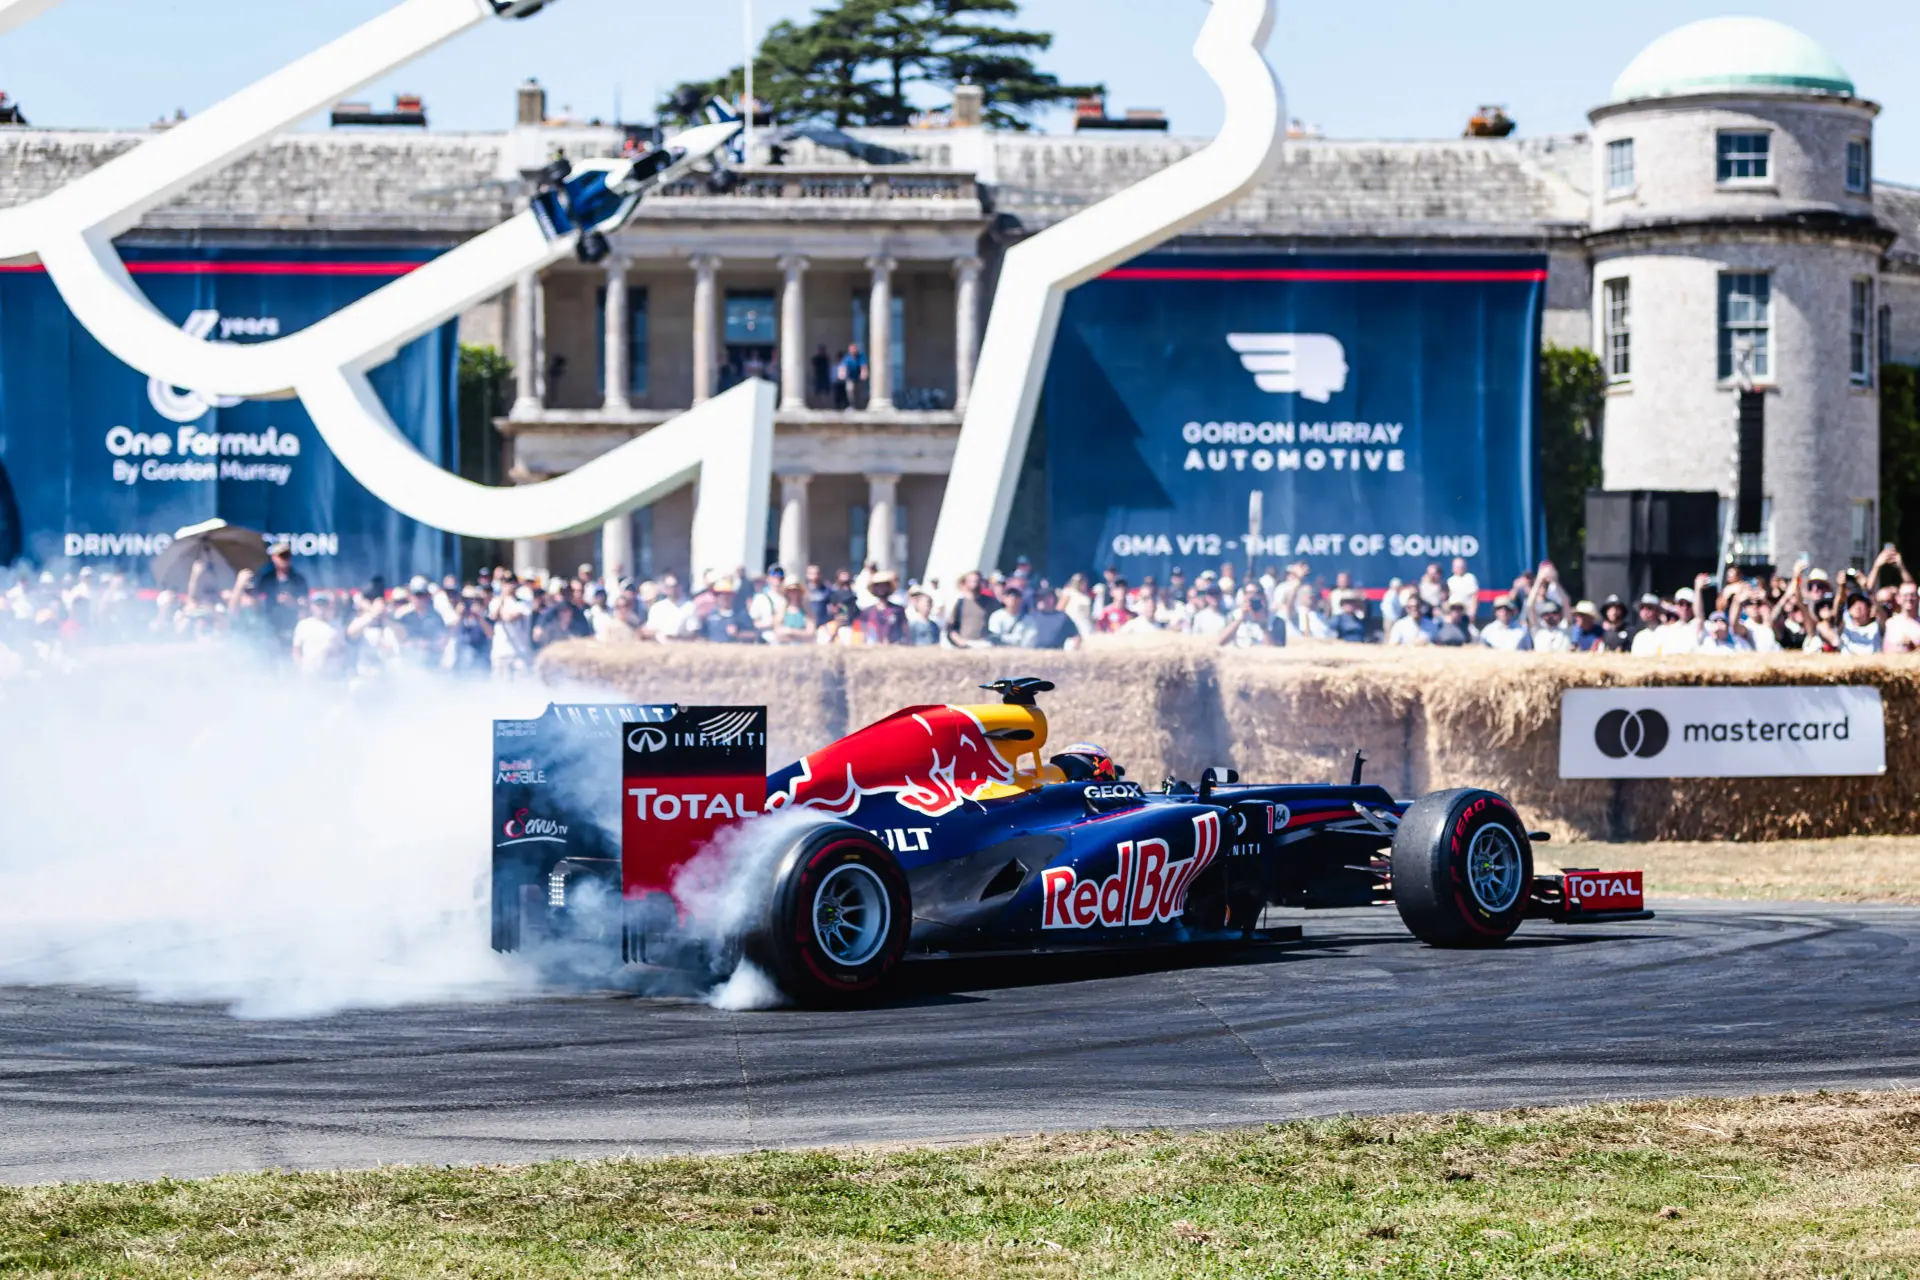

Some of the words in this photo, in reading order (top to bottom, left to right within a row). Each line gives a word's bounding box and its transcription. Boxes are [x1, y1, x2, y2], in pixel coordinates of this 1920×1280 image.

[220, 317, 279, 338] years
[105, 425, 172, 456] One
[177, 425, 300, 456] Formula
[1182, 421, 1295, 444] GORDON
[1300, 421, 1403, 444] MURRAY
[1184, 448, 1405, 471] AUTOMOTIVE
[113, 459, 139, 485] By
[142, 459, 217, 481] Gordon
[219, 460, 291, 485] Murray
[1176, 534, 1222, 556] V12
[1240, 534, 1291, 556] THE
[1295, 534, 1345, 556] ART
[1349, 534, 1385, 556] OF
[1389, 534, 1479, 557] SOUND
[1684, 715, 1849, 742] mastercard
[1083, 784, 1141, 799] GEOX
[628, 788, 758, 821] TOTAL
[1275, 808, 1286, 823] 64
[1266, 805, 1274, 834] 1
[1451, 797, 1486, 857] ZERO
[1041, 840, 1134, 929] Red
[1129, 810, 1221, 927] Bull
[1568, 876, 1640, 897] TOTAL
